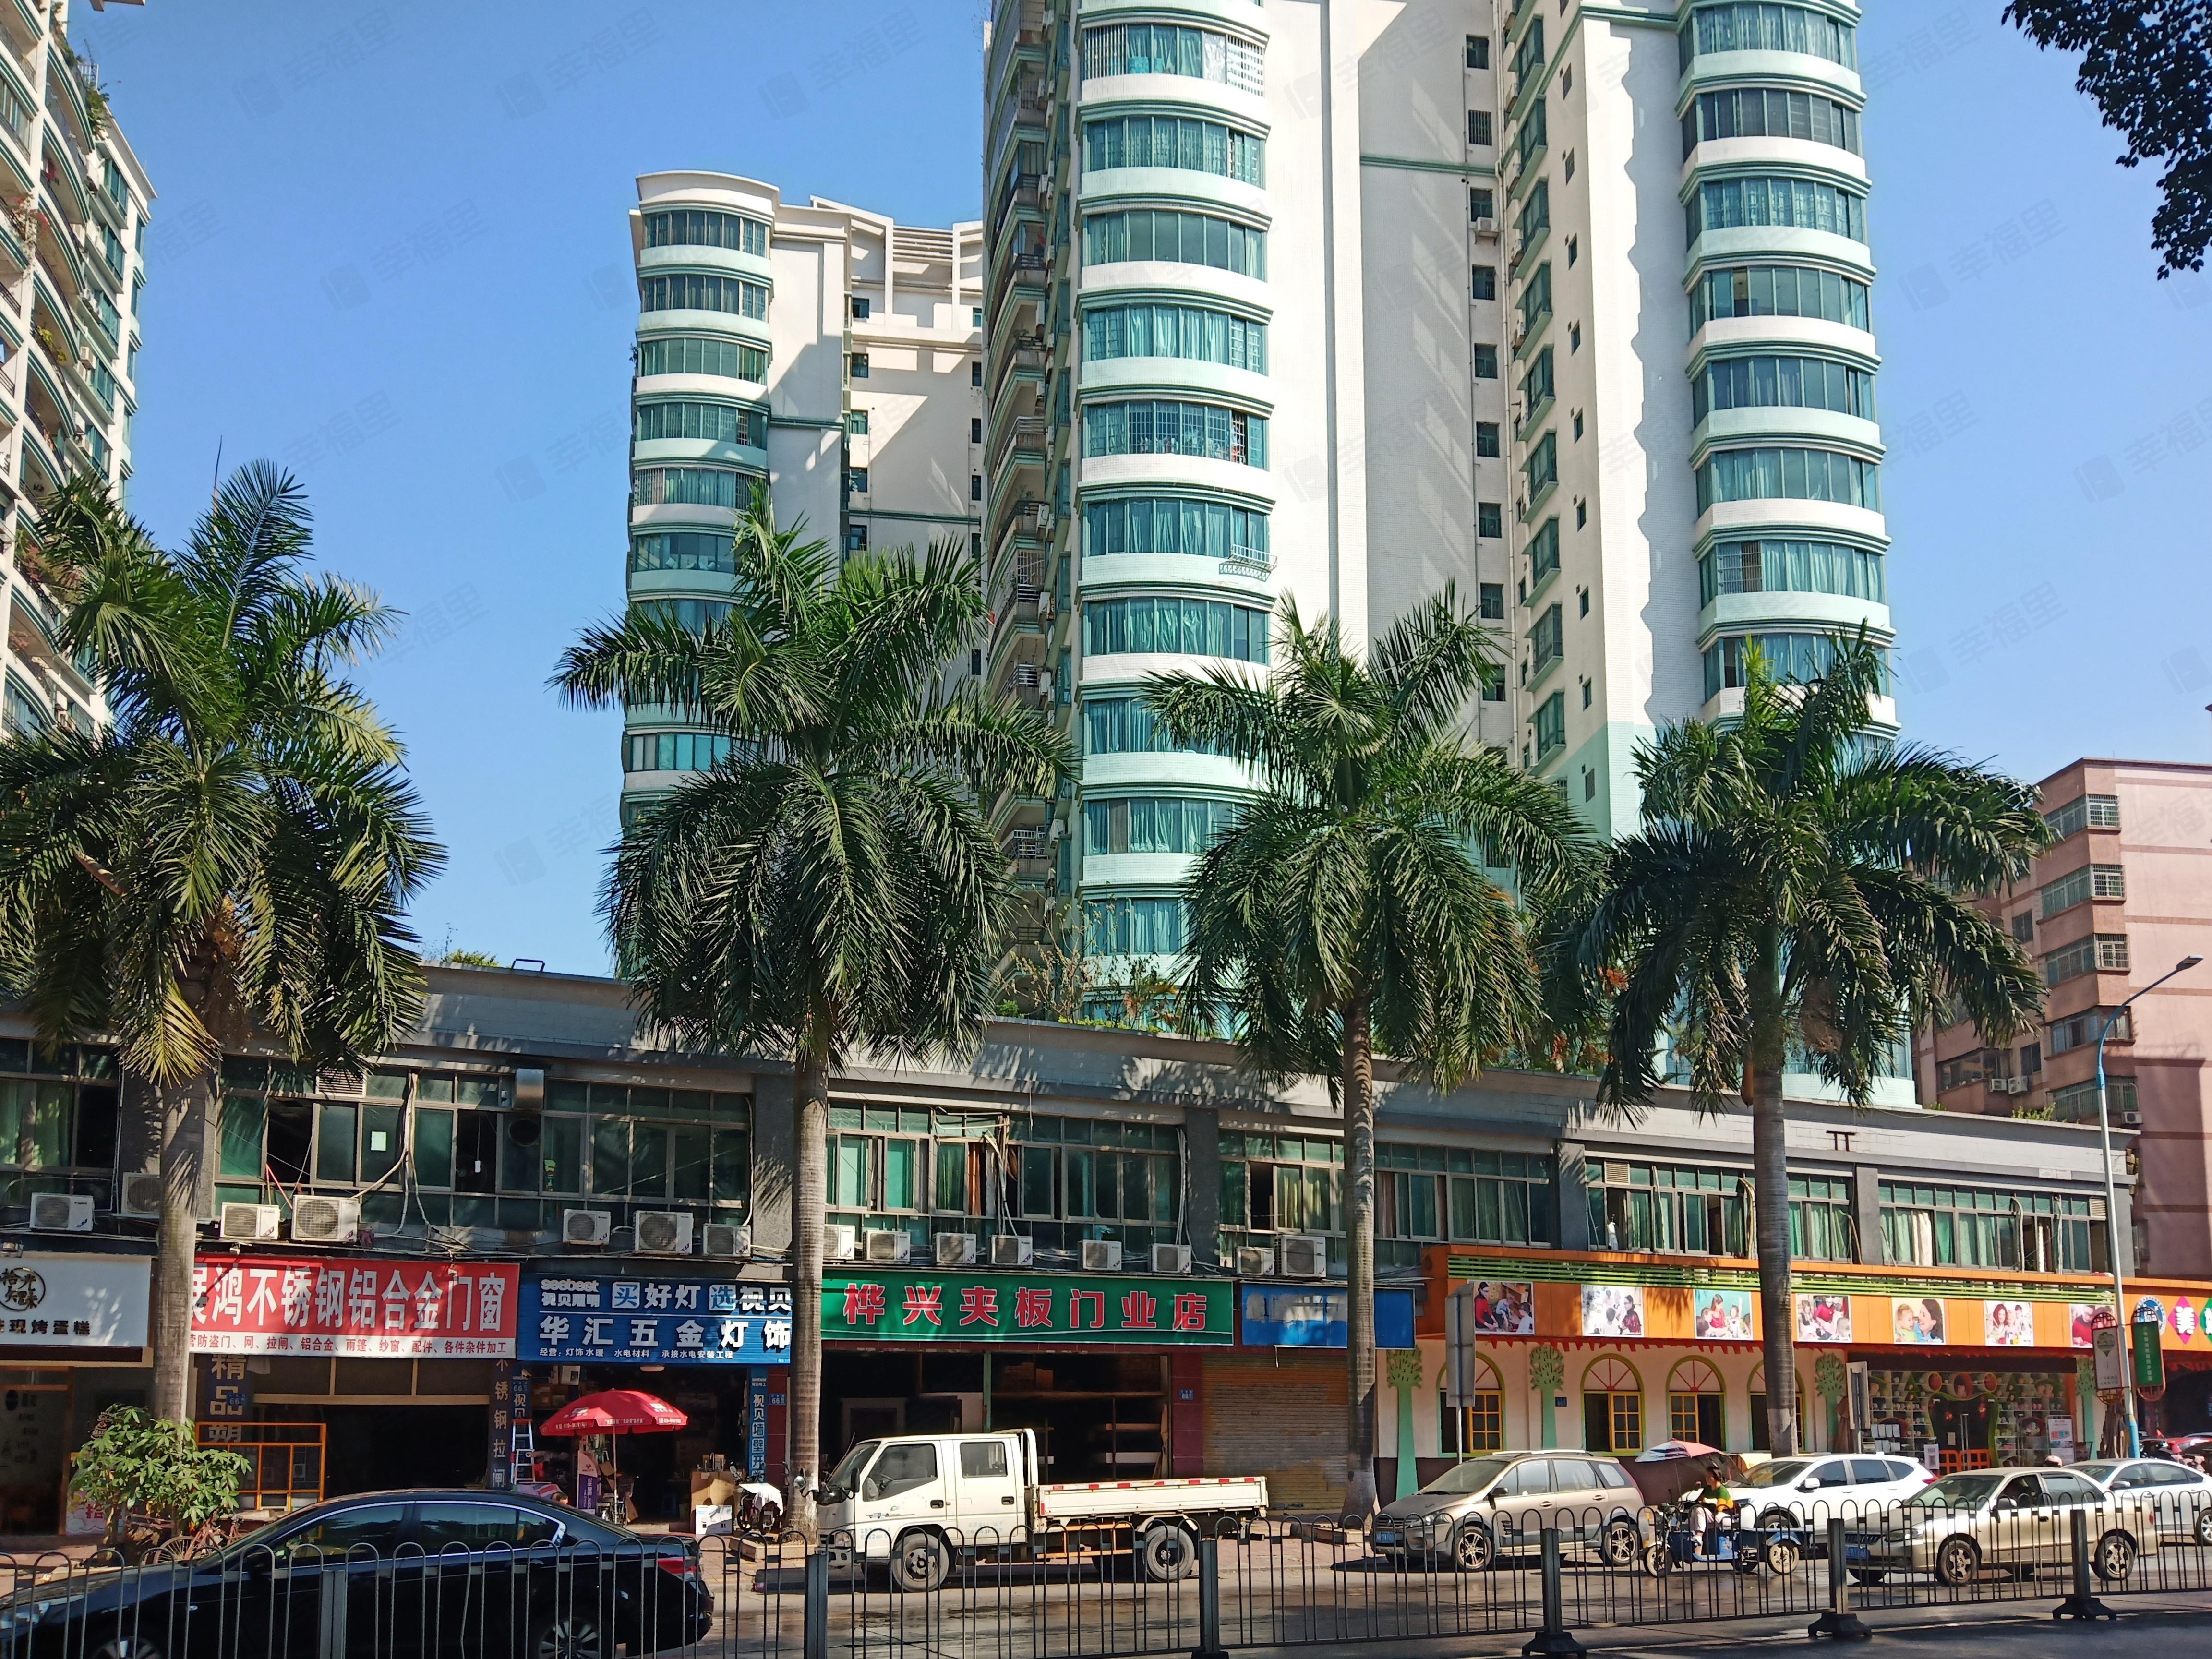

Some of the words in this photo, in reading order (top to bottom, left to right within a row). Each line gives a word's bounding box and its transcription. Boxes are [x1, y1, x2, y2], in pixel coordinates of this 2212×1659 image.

[541, 1279, 599, 1292] seebest
[541, 1292, 600, 1307] 视贝照明
[843, 1283, 1207, 1330] 桦兴夹板门业店
[540, 1315, 791, 1348] 华汇五金灯饰
[614, 1349, 649, 1358] 水电材料
[661, 1350, 733, 1359] 承接水电安装工程
